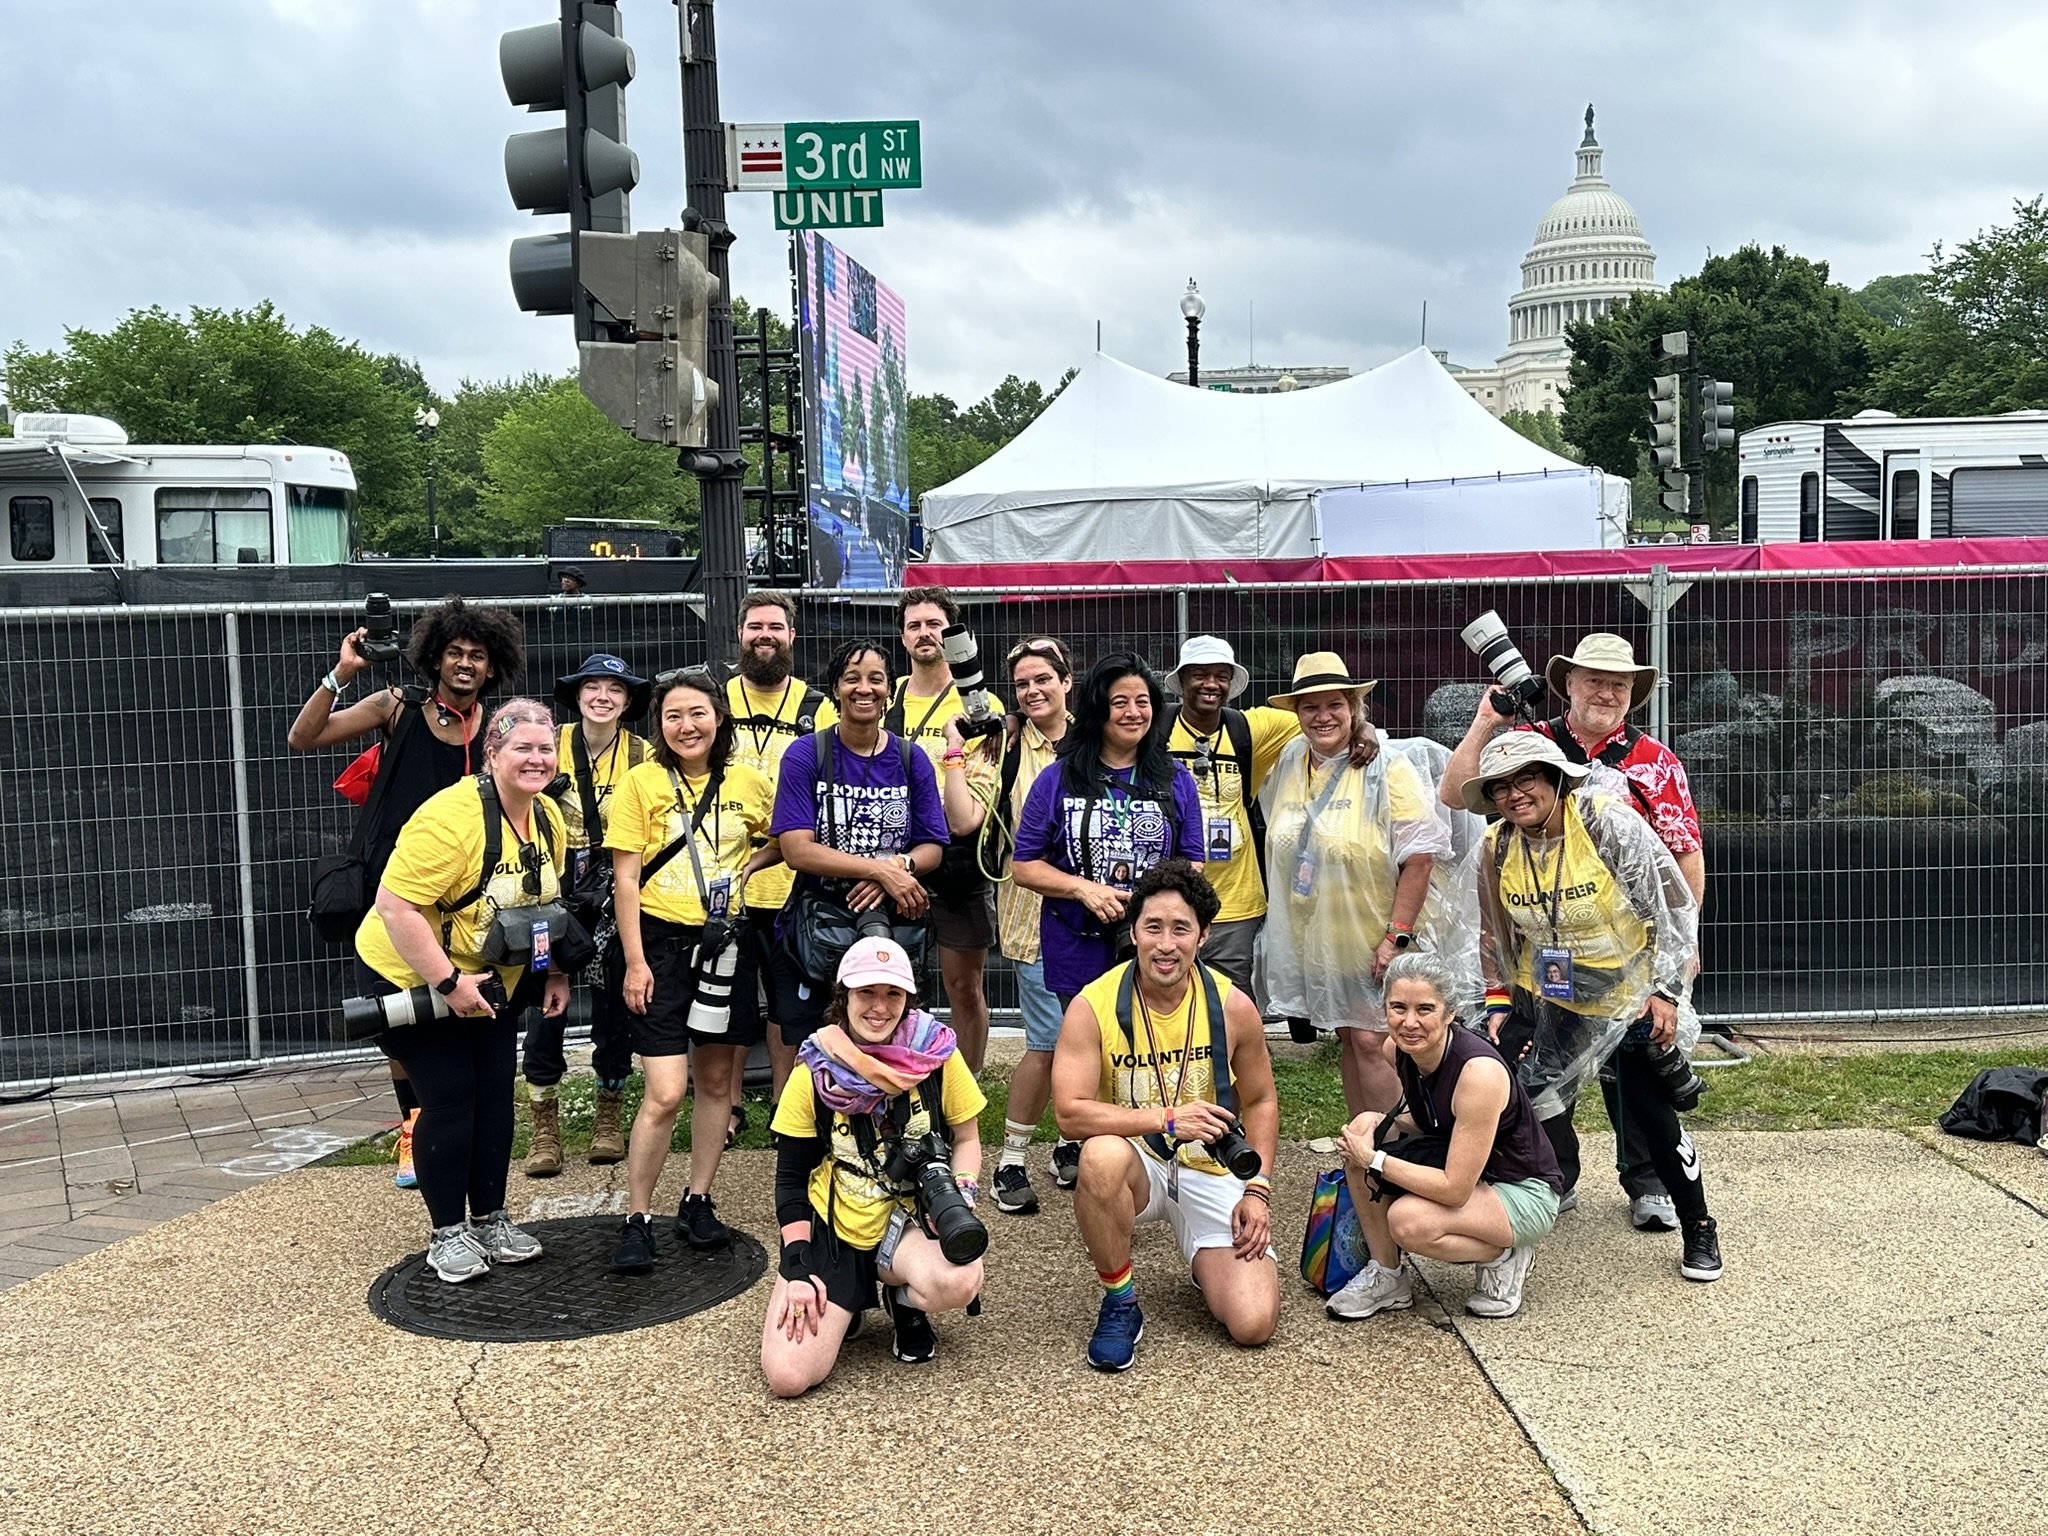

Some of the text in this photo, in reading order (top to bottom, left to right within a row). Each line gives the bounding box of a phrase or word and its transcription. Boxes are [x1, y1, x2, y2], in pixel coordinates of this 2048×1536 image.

[882, 129, 908, 151] ST
[795, 132, 868, 181] 3rd
[881, 157, 911, 180] NW
[778, 190, 879, 226] UNIT
